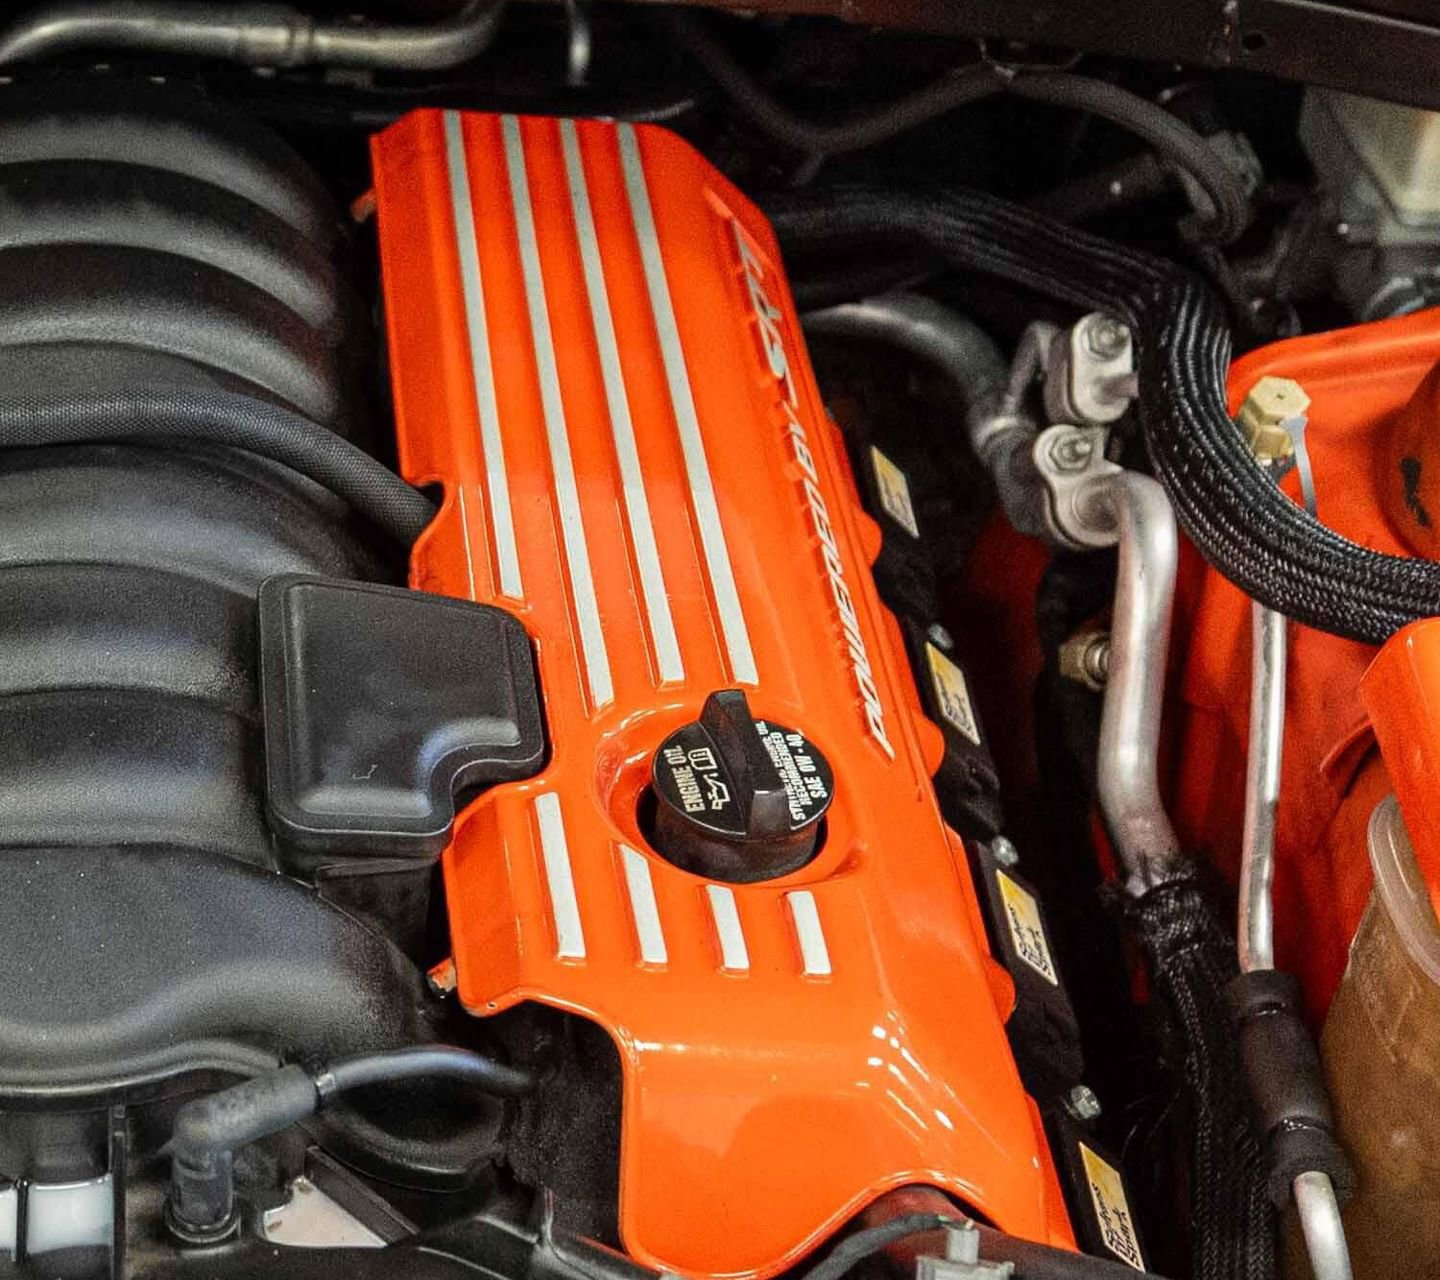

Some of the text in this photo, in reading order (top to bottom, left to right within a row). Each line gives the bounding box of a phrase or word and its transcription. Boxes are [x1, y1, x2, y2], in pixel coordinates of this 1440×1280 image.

[733, 219, 799, 410] SRT
[804, 477, 895, 761] POWERED
[663, 745, 706, 813] ENGINE OIL
[804, 775, 828, 799] SAE
